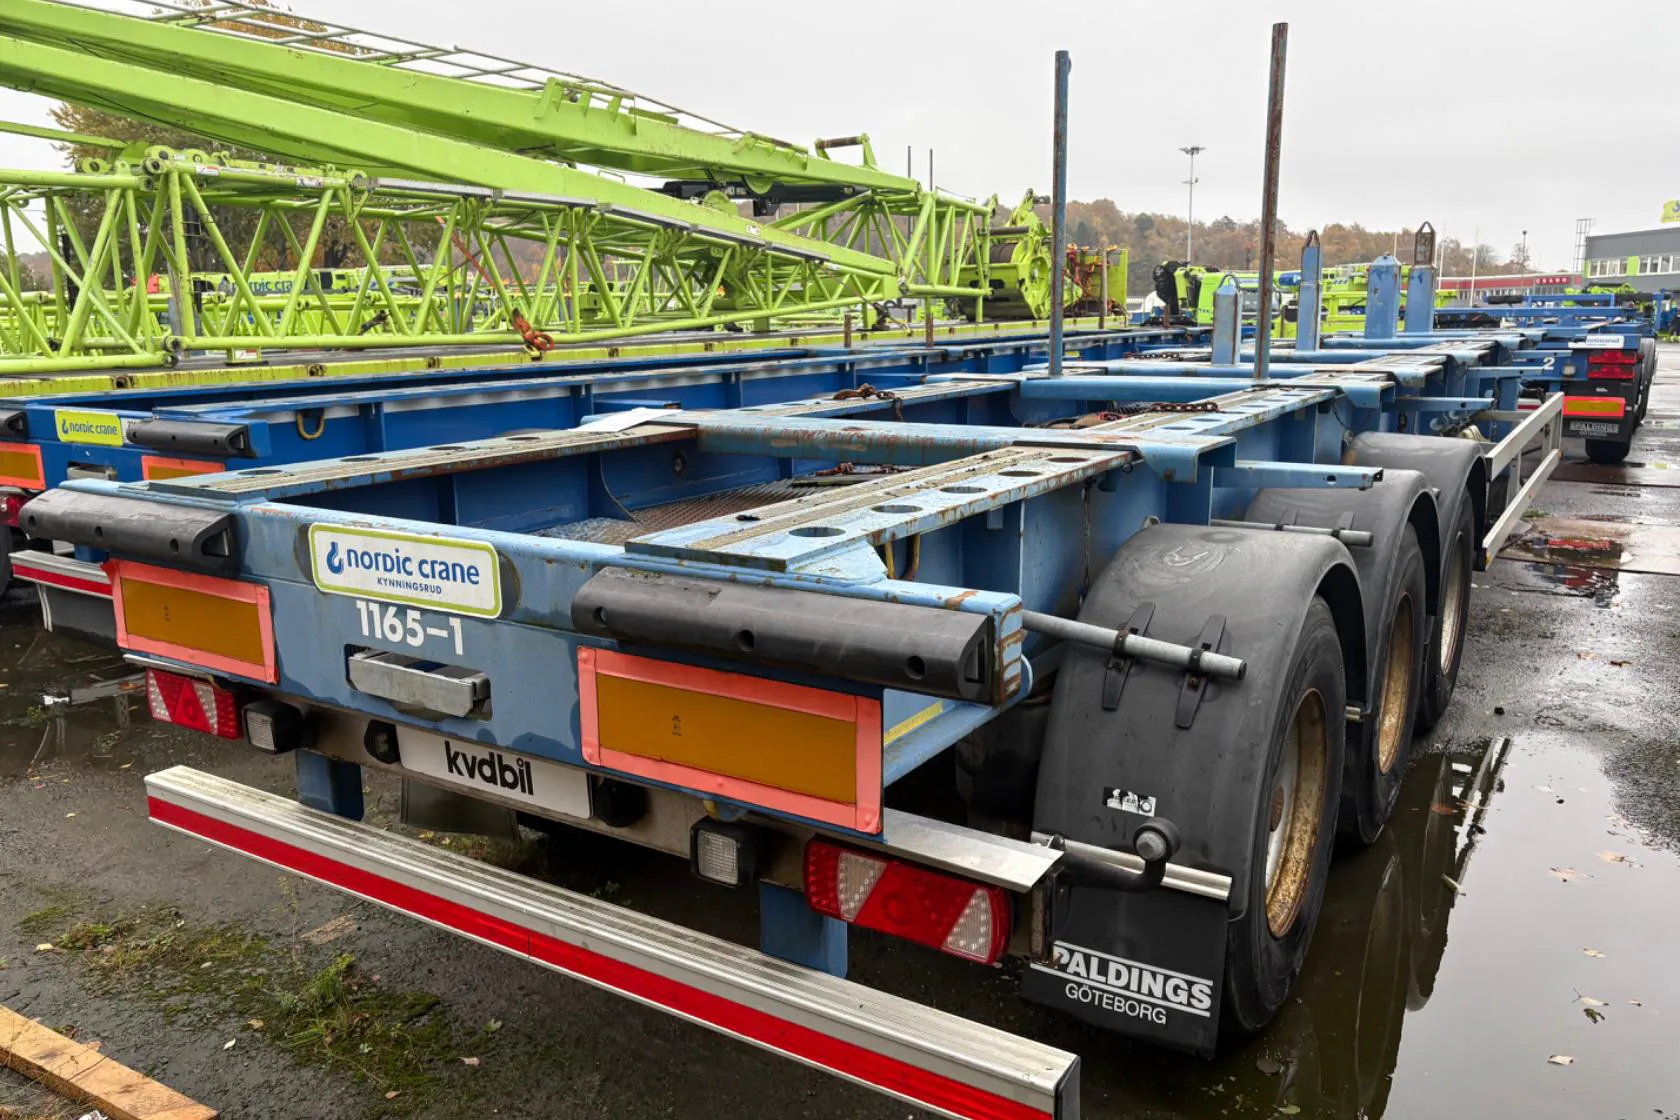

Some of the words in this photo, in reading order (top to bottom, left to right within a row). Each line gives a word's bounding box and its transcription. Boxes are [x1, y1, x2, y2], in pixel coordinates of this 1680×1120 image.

[69, 421, 95, 433] nordic
[95, 425, 118, 435] crane
[347, 548, 413, 576] nordic
[418, 558, 480, 585] crane
[377, 577, 442, 594] KYNNINGSRUD
[356, 600, 463, 655] 1165-1
[445, 740, 534, 796] kvdbil
[1045, 944, 1212, 1010] PALDINGS
[1065, 982, 1167, 1024] GÖTEBORG
